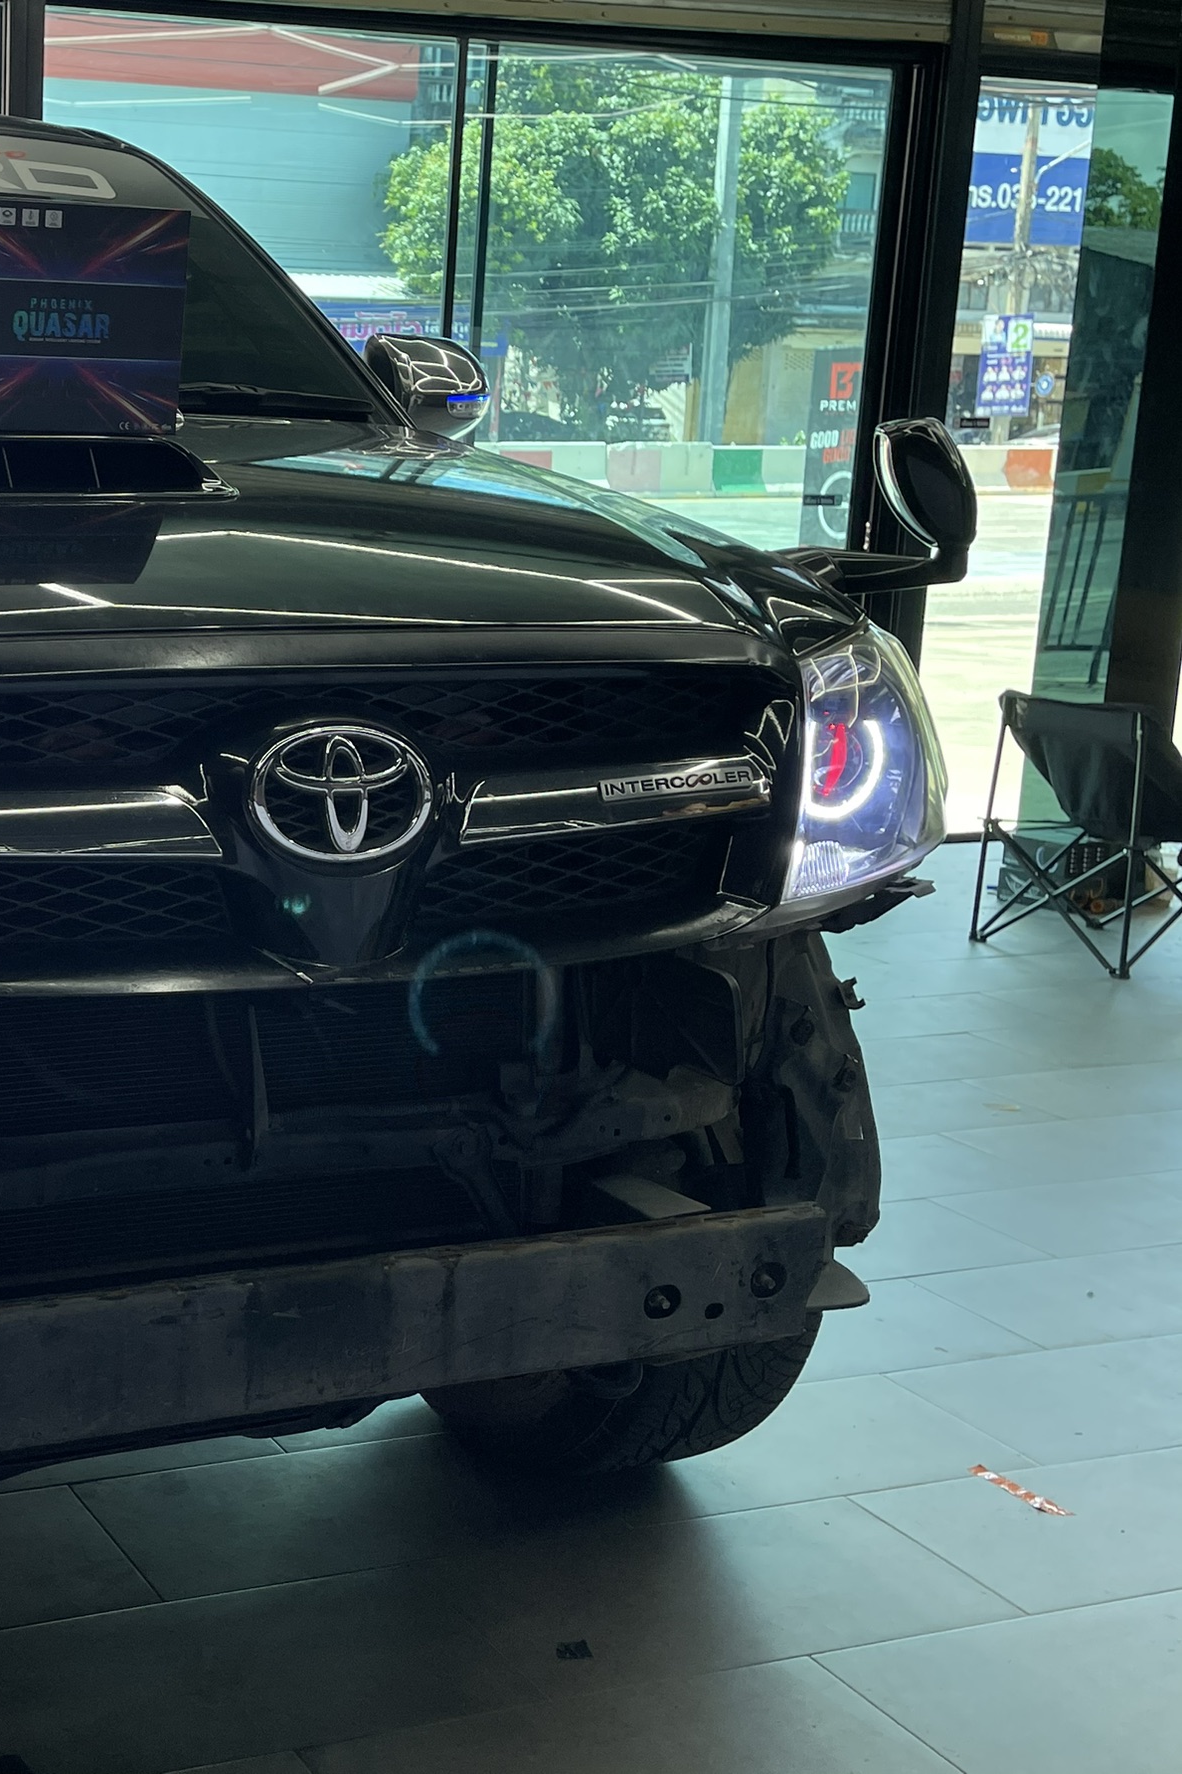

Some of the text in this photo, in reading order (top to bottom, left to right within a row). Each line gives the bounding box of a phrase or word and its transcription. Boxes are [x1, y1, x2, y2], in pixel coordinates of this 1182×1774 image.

[30, 298, 93, 310] PHOENIX
[12, 311, 110, 341] QUASAR
[1011, 324, 1029, 348] 2
[810, 429, 840, 449] GOOD
[604, 771, 751, 796] INTERCOOLER
